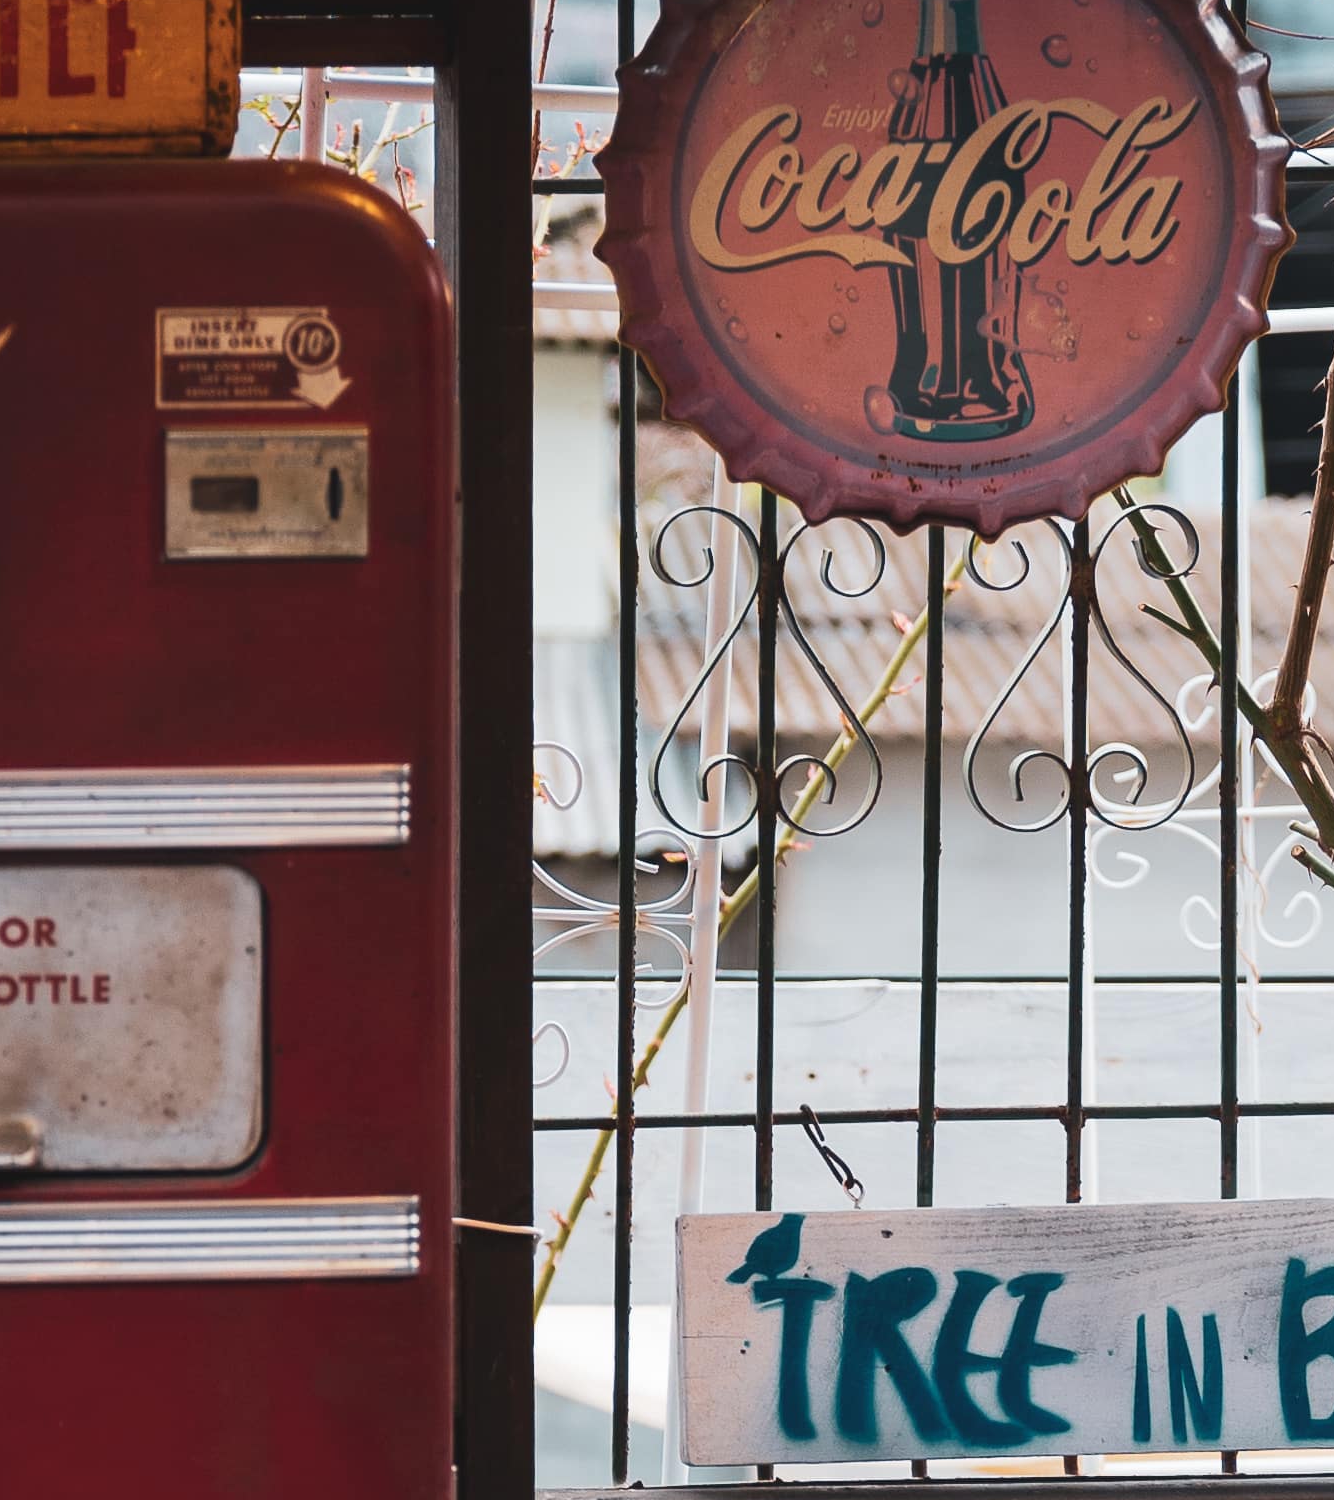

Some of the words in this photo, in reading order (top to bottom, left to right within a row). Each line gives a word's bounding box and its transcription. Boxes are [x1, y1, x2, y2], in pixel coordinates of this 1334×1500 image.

[821, 101, 893, 132] Enjoy!
[689, 94, 1198, 272] Coca-Cola
[173, 337, 220, 350] DIME
[228, 335, 276, 350] ONLY
[190, 320, 258, 334] INSERT
[750, 1266, 1078, 1446] TREE
[1132, 1305, 1223, 1444] IN
